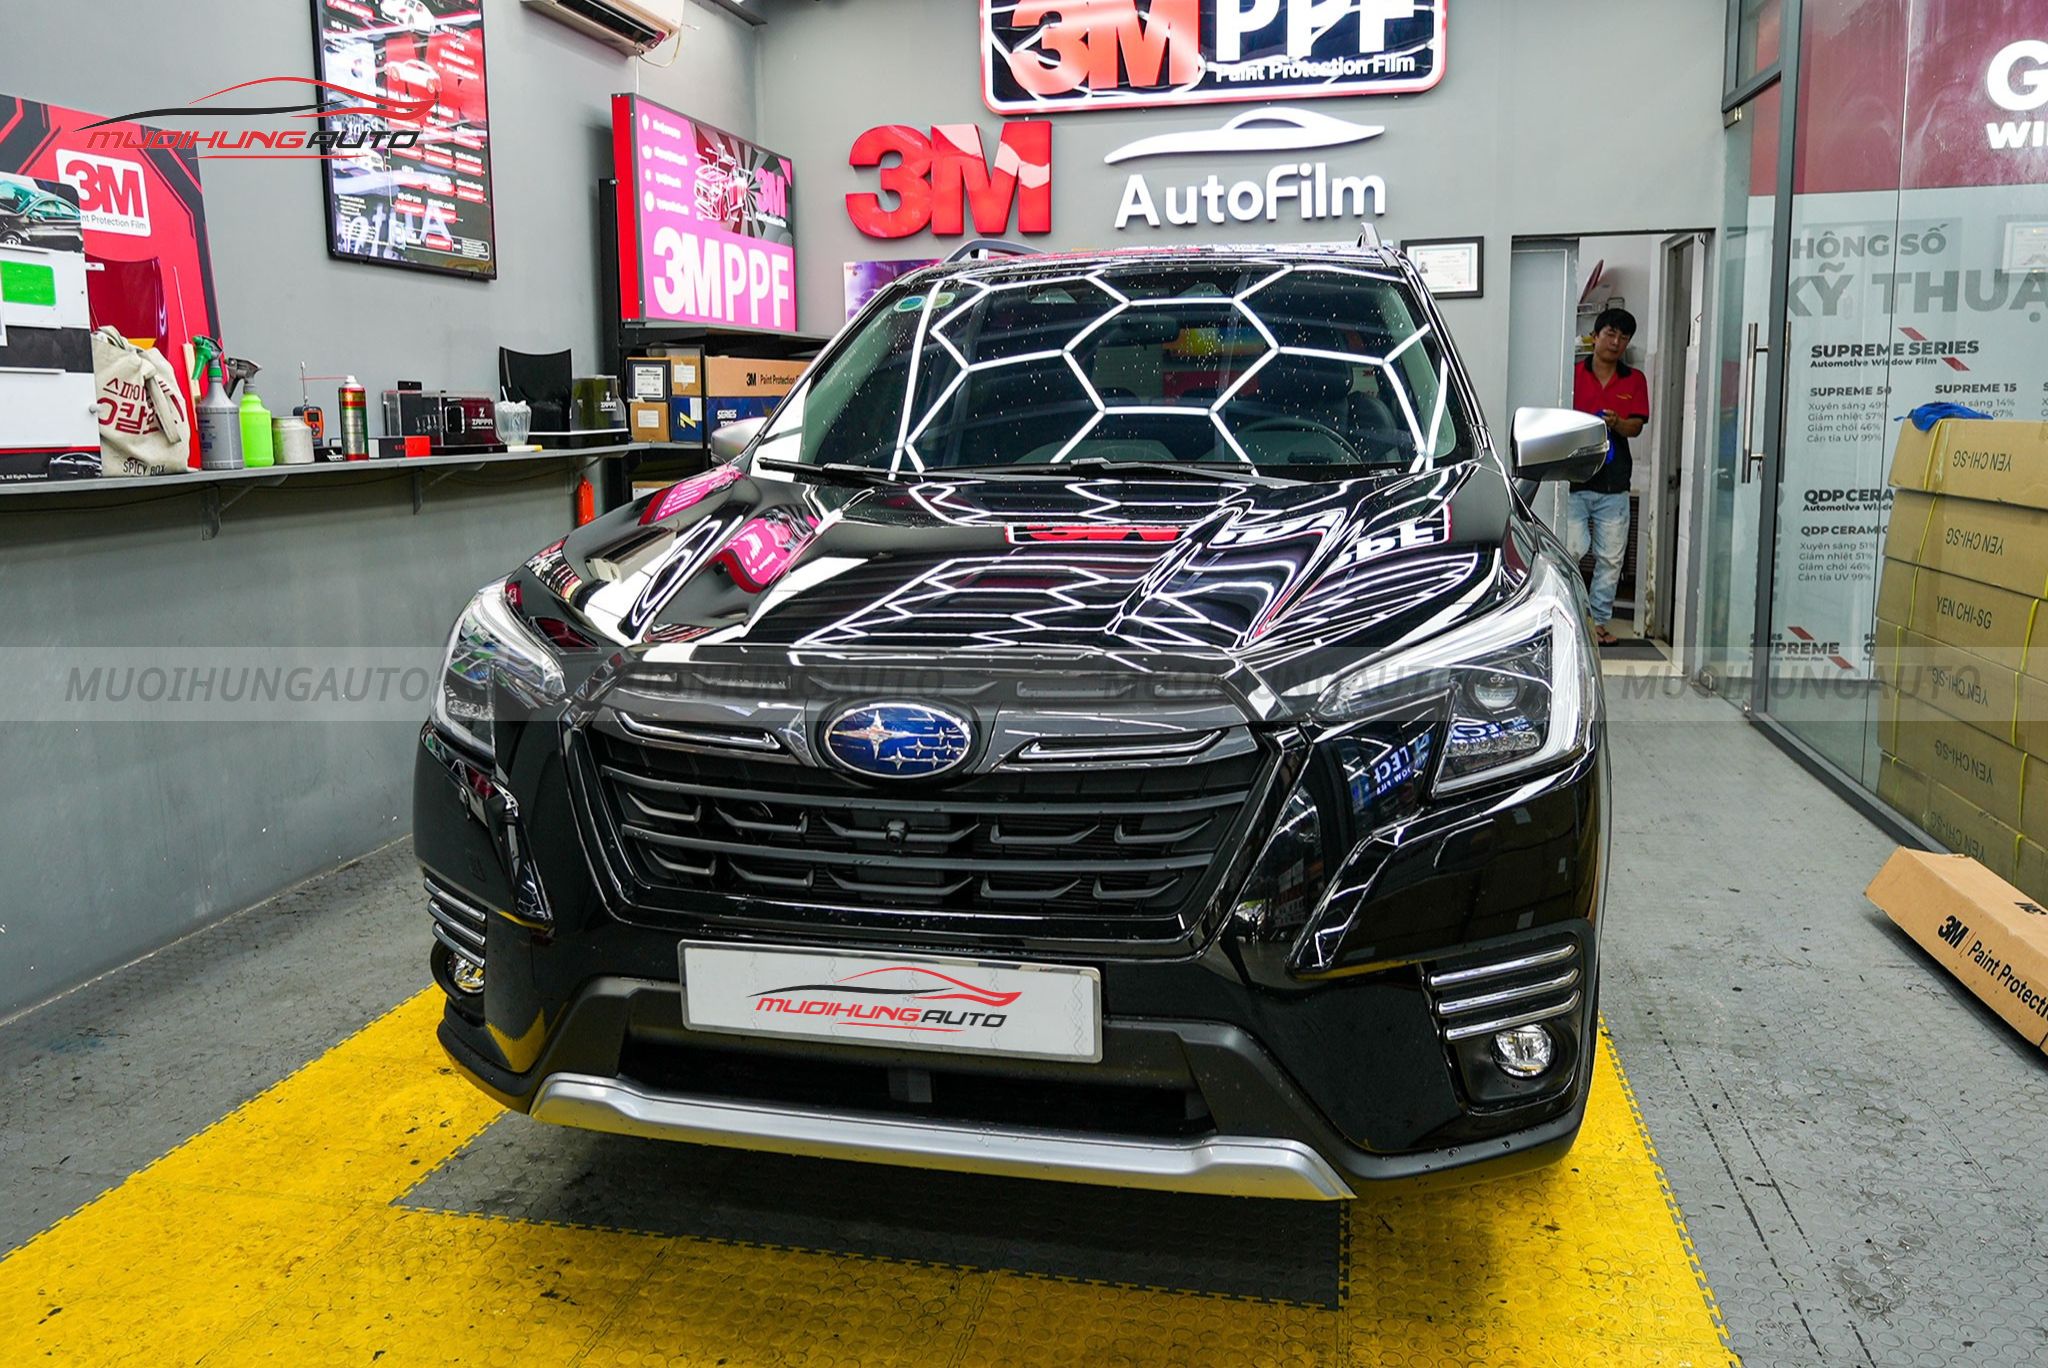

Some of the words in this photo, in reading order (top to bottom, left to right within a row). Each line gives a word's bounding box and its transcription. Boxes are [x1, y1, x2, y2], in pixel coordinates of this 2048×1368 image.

[1011, 0, 1200, 95] 3M
[1216, 0, 1415, 62] PPF
[1216, 61, 1265, 82] Paint
[1268, 57, 1369, 80] Protection
[1372, 54, 1415, 73] Film
[1986, 120, 2048, 149] WI
[65, 160, 144, 218] 3M
[846, 121, 1052, 239] 3M
[755, 167, 788, 218] 3M
[1114, 162, 1386, 229] AutoFilm
[91, 214, 130, 228] Protection
[131, 220, 147, 230] Film
[1792, 230, 1890, 259] HÔNG
[1900, 223, 1949, 256] SỐ
[1811, 343, 1905, 358] SUPREME
[1909, 340, 1980, 355] SERIES
[1810, 359, 1869, 368] Automotive
[1915, 357, 1938, 366] Film
[746, 372, 758, 387] 3M
[760, 374, 773, 384] Paint
[1935, 383, 2000, 394] SUPREME
[2003, 383, 2017, 392] 15
[1810, 386, 1873, 397] SUPREME
[1876, 386, 1892, 396] 50
[1996, 399, 2015, 407] 14%
[1993, 409, 2014, 418] 67%
[1844, 434, 1859, 442] UV
[123, 461, 148, 476] SPICY
[150, 464, 167, 476] BOX
[1989, 453, 2013, 473] YEN
[1804, 489, 1845, 505] QDP
[1801, 526, 1830, 537] QDP
[1981, 534, 2005, 556] YEN
[1834, 573, 1849, 581] UV
[1936, 596, 1956, 617] YEN
[1956, 602, 1993, 630] CHI-SG
[1750, 642, 1840, 655] PREME
[1967, 681, 1988, 706] YEN
[1971, 758, 1994, 785] YEN
[1938, 915, 1969, 949] 3M
[1967, 940, 2001, 977] Paint
